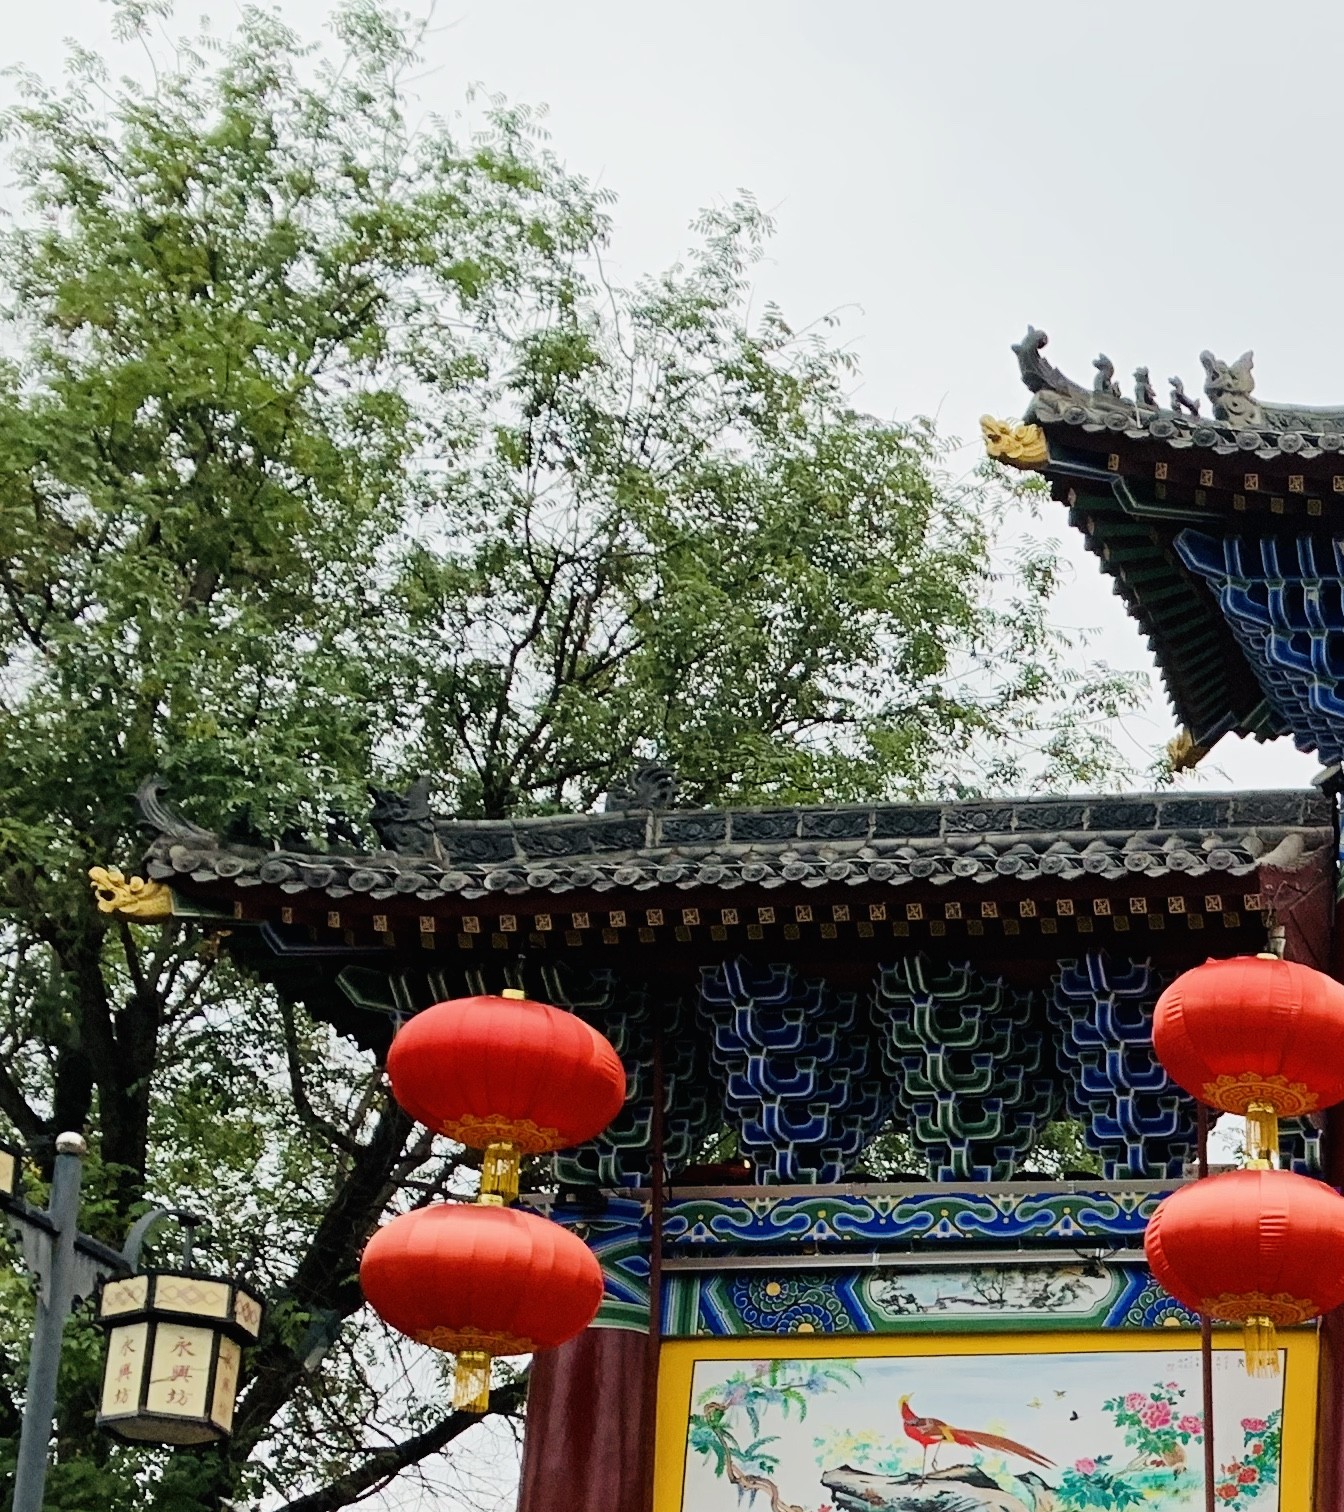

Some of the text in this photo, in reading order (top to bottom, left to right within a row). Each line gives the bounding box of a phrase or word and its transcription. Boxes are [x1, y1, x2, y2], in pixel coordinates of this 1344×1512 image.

[113, 1336, 137, 1405] 永興坊
[166, 1335, 197, 1406] 永興坊
